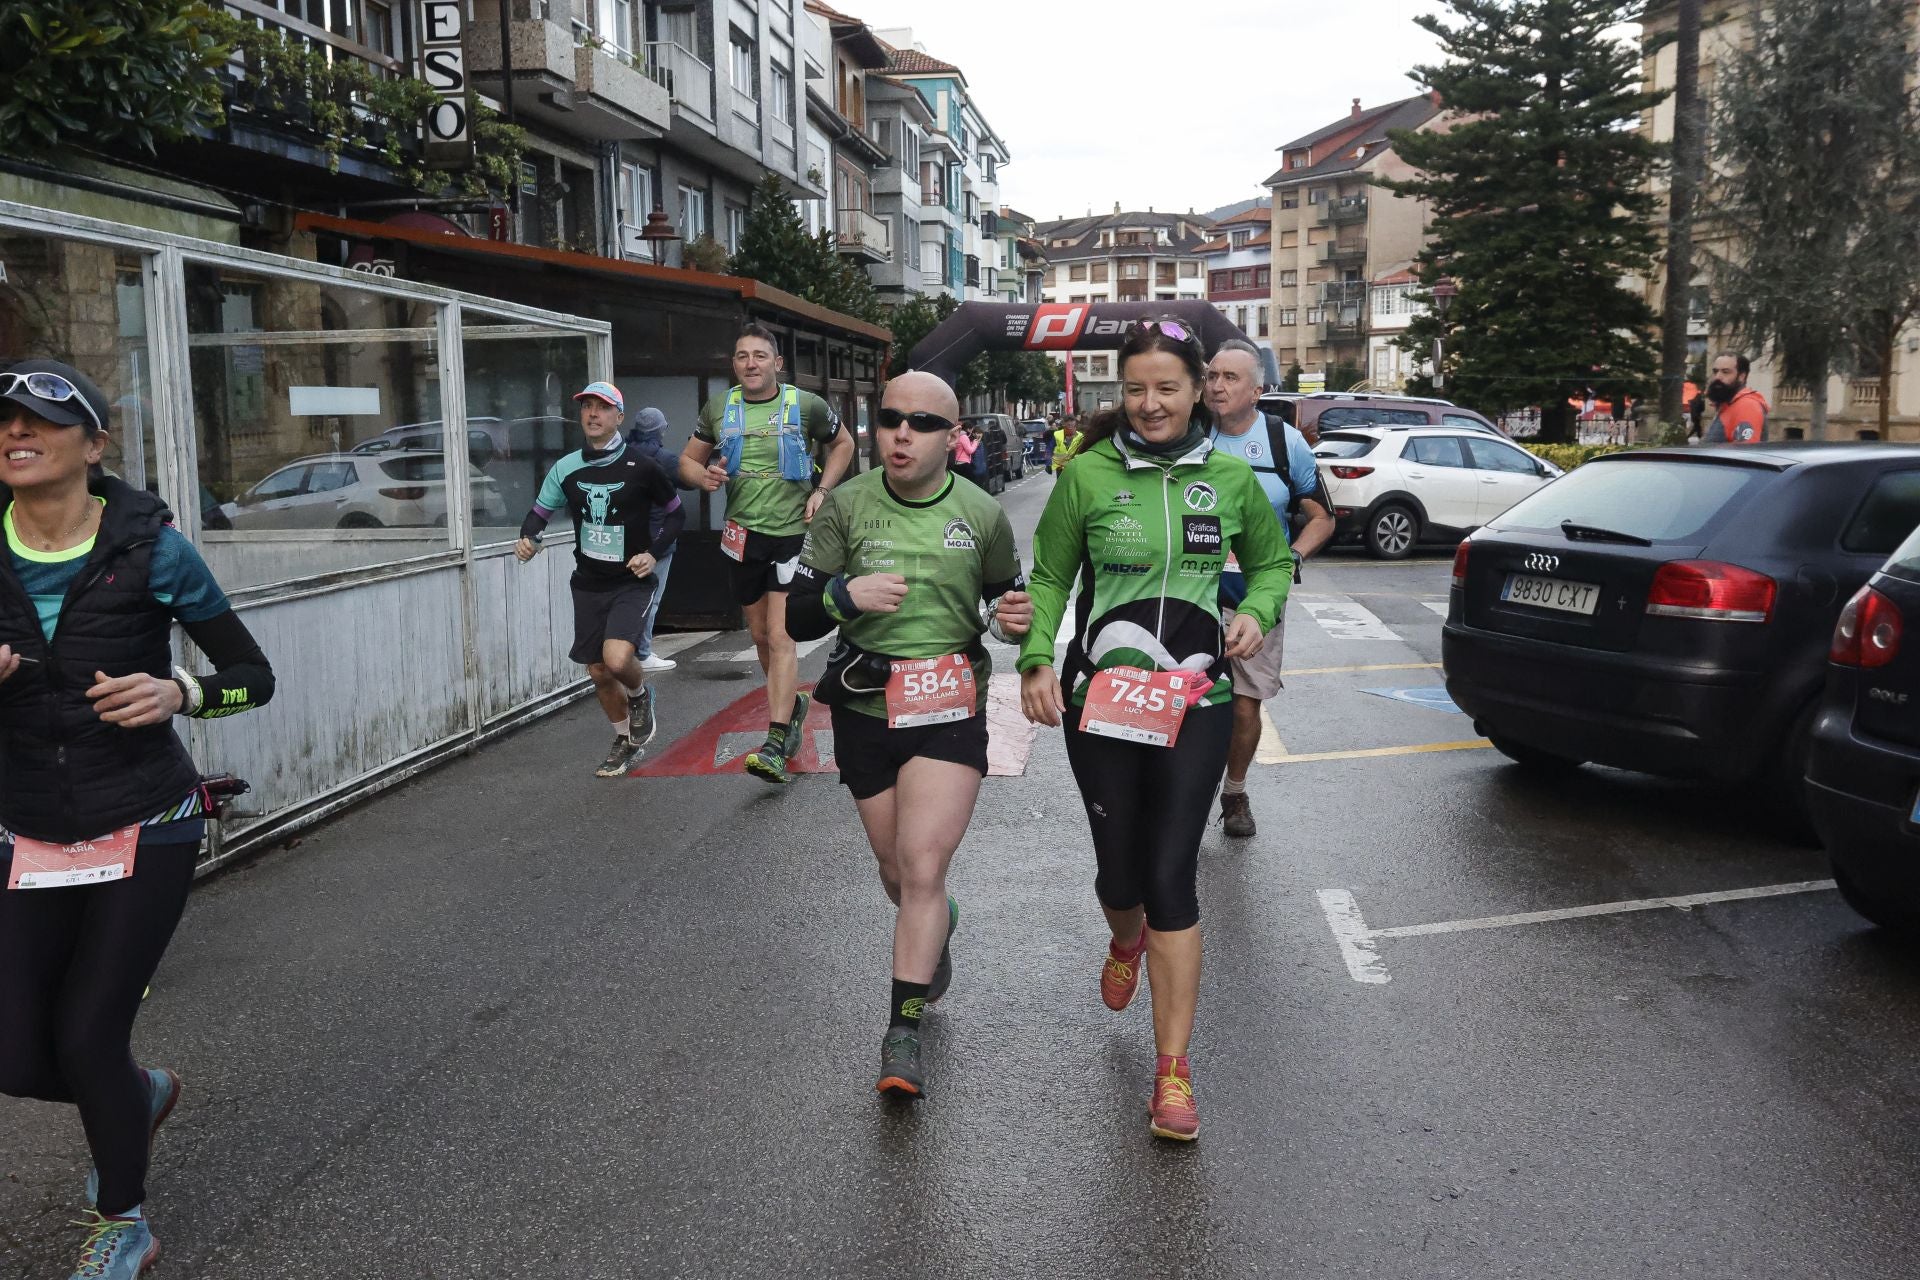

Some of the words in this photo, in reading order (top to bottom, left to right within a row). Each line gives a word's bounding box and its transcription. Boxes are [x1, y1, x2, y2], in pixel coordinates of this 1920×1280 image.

[723, 526, 737, 542] 23
[1188, 523, 1218, 533] Gráficas
[587, 529, 612, 545] 213
[947, 540, 973, 548] MOAL
[1187, 531, 1221, 544] Verano
[1512, 577, 1554, 604] 9830
[1557, 584, 1593, 609] CXT
[903, 668, 959, 696] 584
[904, 695, 924, 703] JUAN
[932, 689, 960, 699] LLAMES
[1110, 678, 1167, 712] 745
[1124, 704, 1144, 715] LUCY
[62, 842, 95, 855] MARÍA
